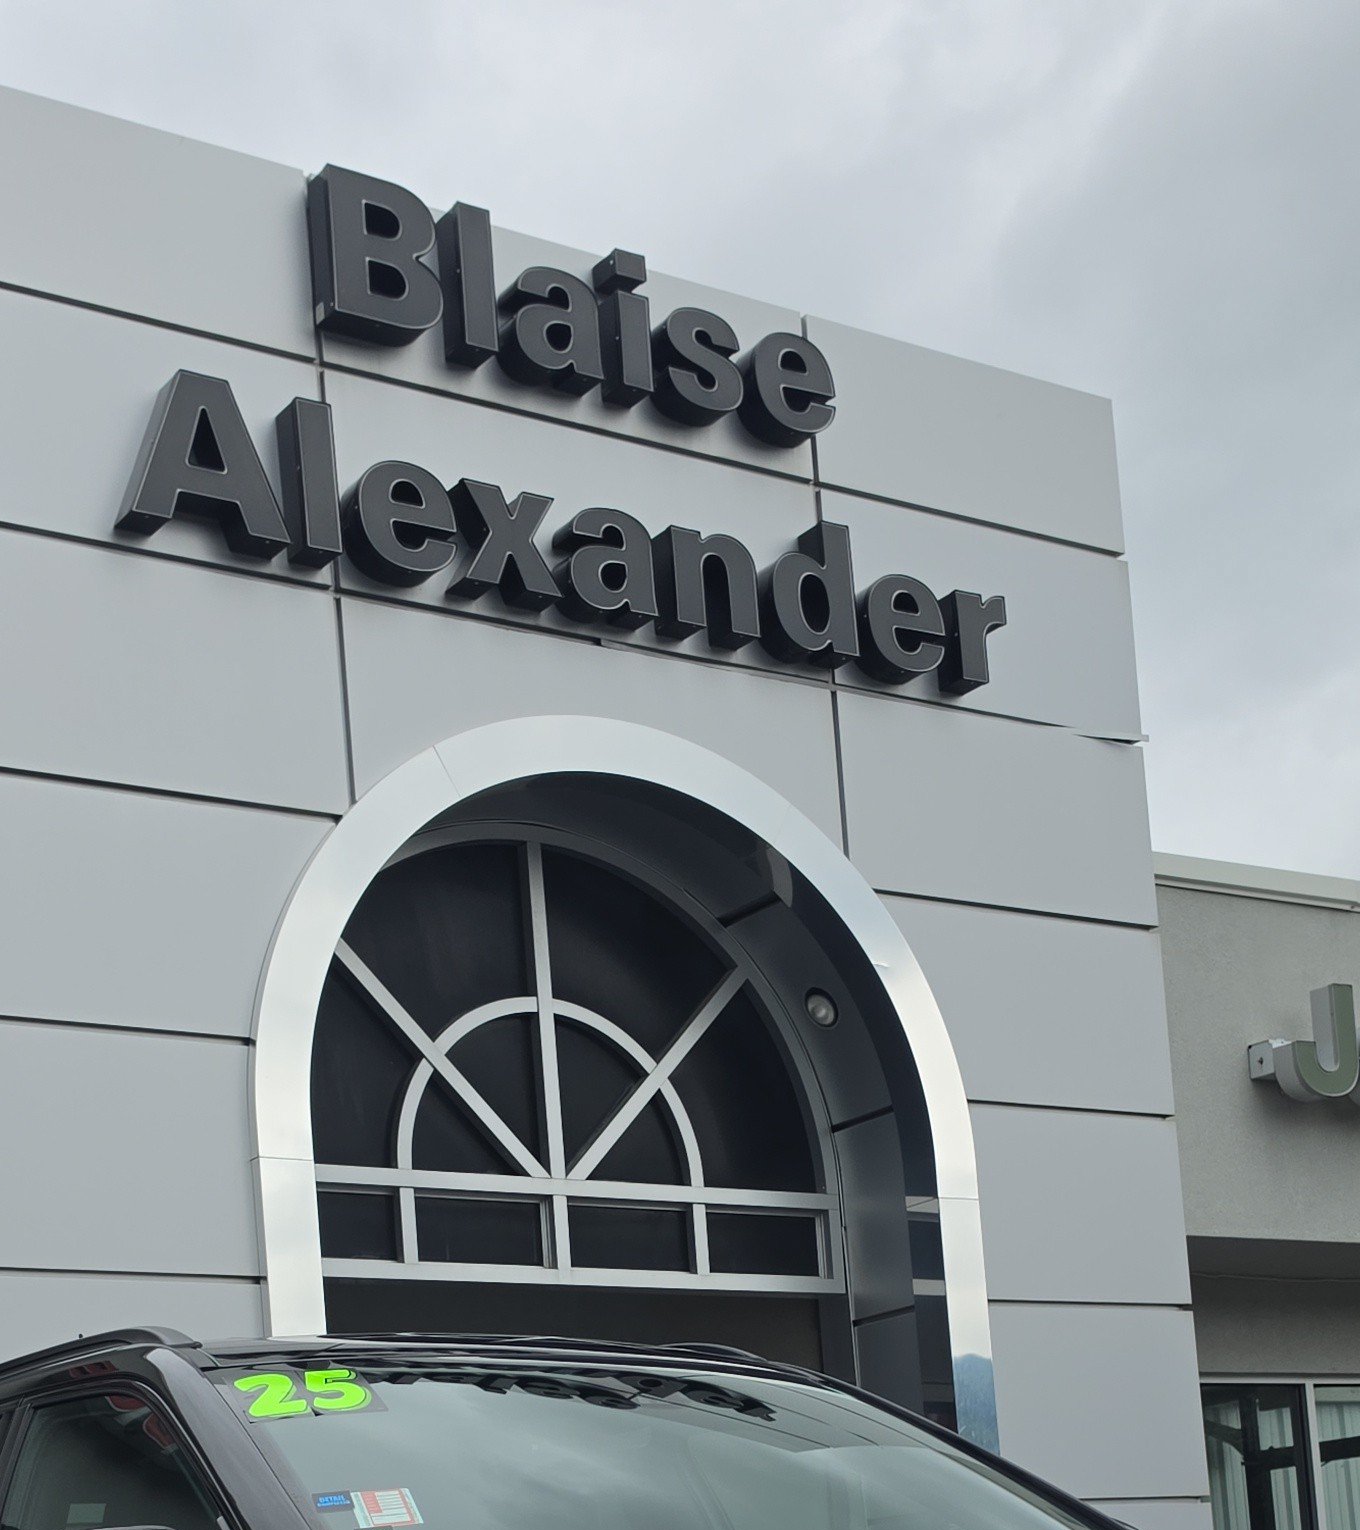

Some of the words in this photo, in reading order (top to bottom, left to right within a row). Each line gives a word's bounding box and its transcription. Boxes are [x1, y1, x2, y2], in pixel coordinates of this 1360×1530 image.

[307, 163, 836, 447] Blaise
[114, 368, 1006, 695] Alexander
[234, 1369, 372, 1418] 25
